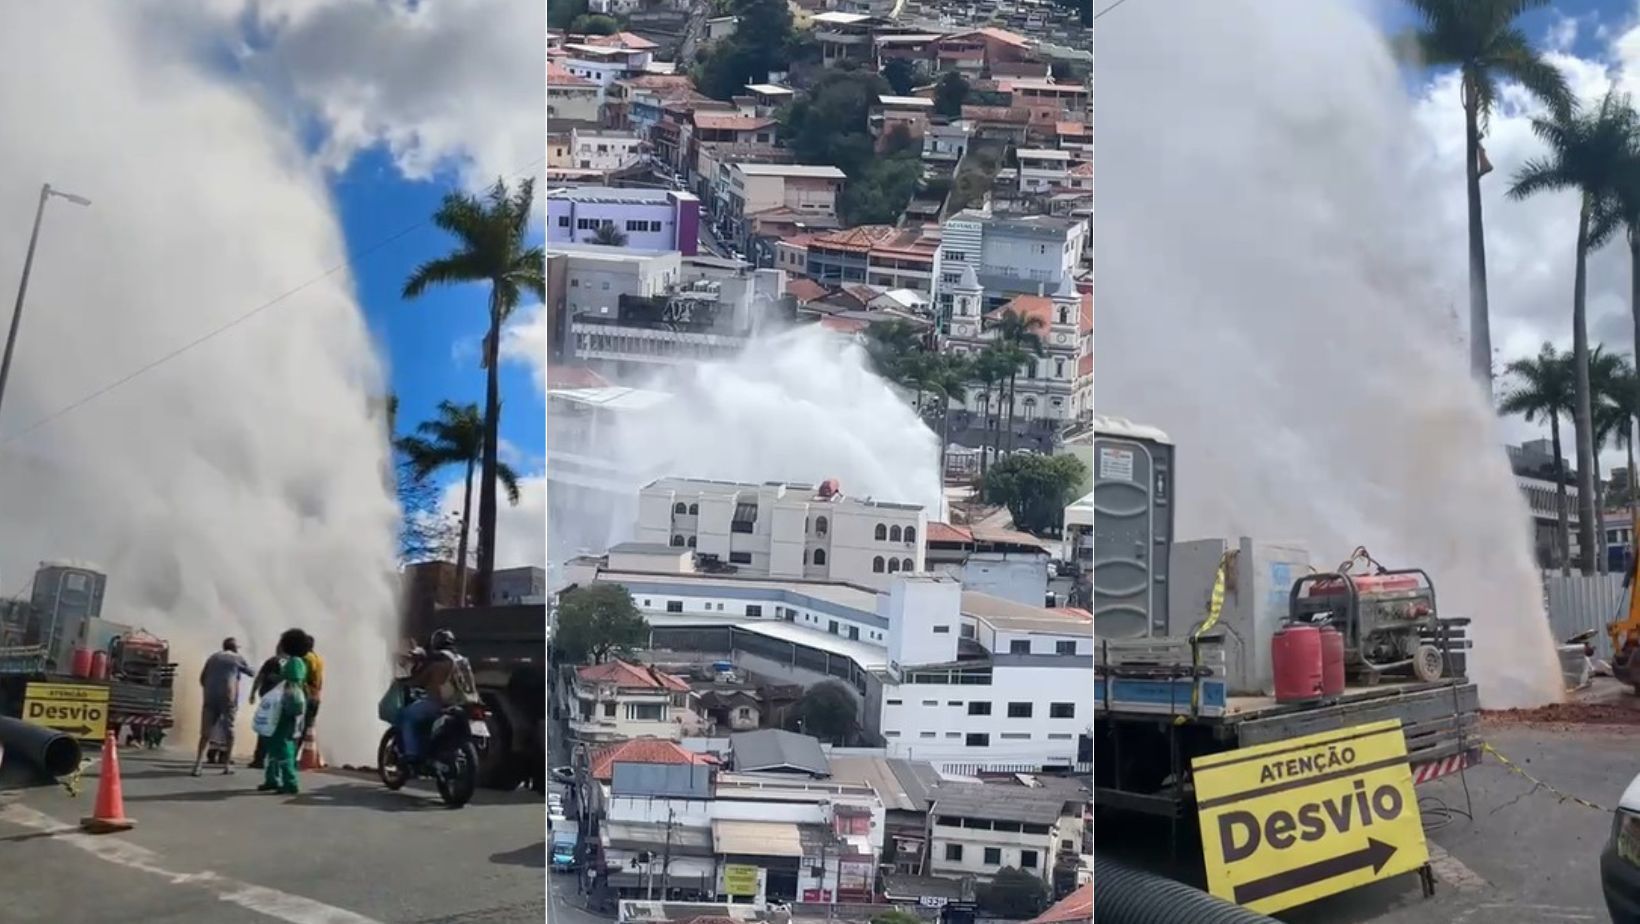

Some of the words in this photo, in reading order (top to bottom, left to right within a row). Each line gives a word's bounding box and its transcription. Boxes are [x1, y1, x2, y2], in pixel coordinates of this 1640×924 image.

[29, 702, 101, 721] Desvio
[1259, 745, 1356, 783] ATENÇÃO
[1217, 779, 1403, 864] Desvio
